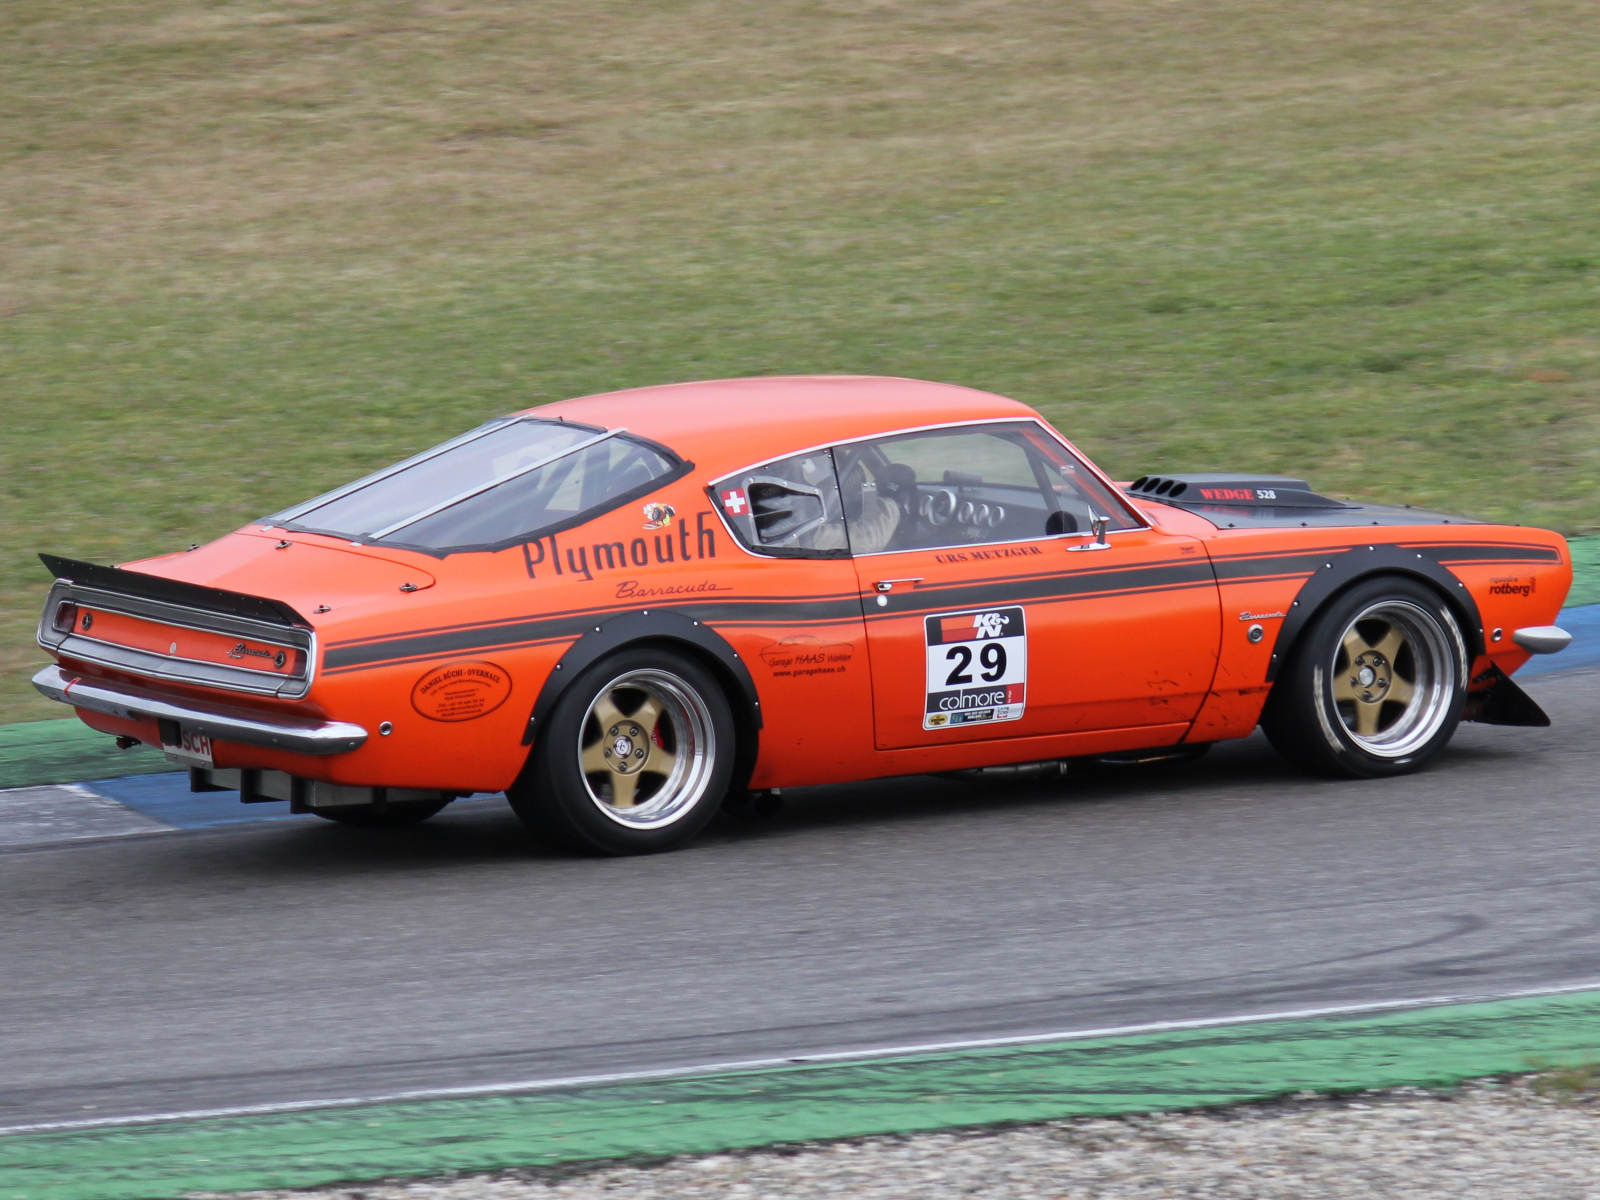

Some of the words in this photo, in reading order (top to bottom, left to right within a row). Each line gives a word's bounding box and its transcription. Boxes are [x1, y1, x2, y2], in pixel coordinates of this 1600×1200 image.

[1200, 488, 1255, 501] WEDGE
[1256, 489, 1276, 499] 528
[522, 510, 716, 582] Plymouth
[934, 552, 968, 564] URS
[970, 546, 1042, 561] METZGER
[615, 580, 733, 599] Barracuda
[1489, 583, 1530, 597] rotberg
[794, 652, 825, 665] HAAS
[945, 642, 1007, 686] 29
[773, 665, 846, 678] www.garagehaas.ch
[420, 676, 443, 695] DANIEL
[443, 669, 463, 681] BÜCHI
[467, 668, 501, 684] OVERHAUL
[939, 689, 1005, 711] colmore
